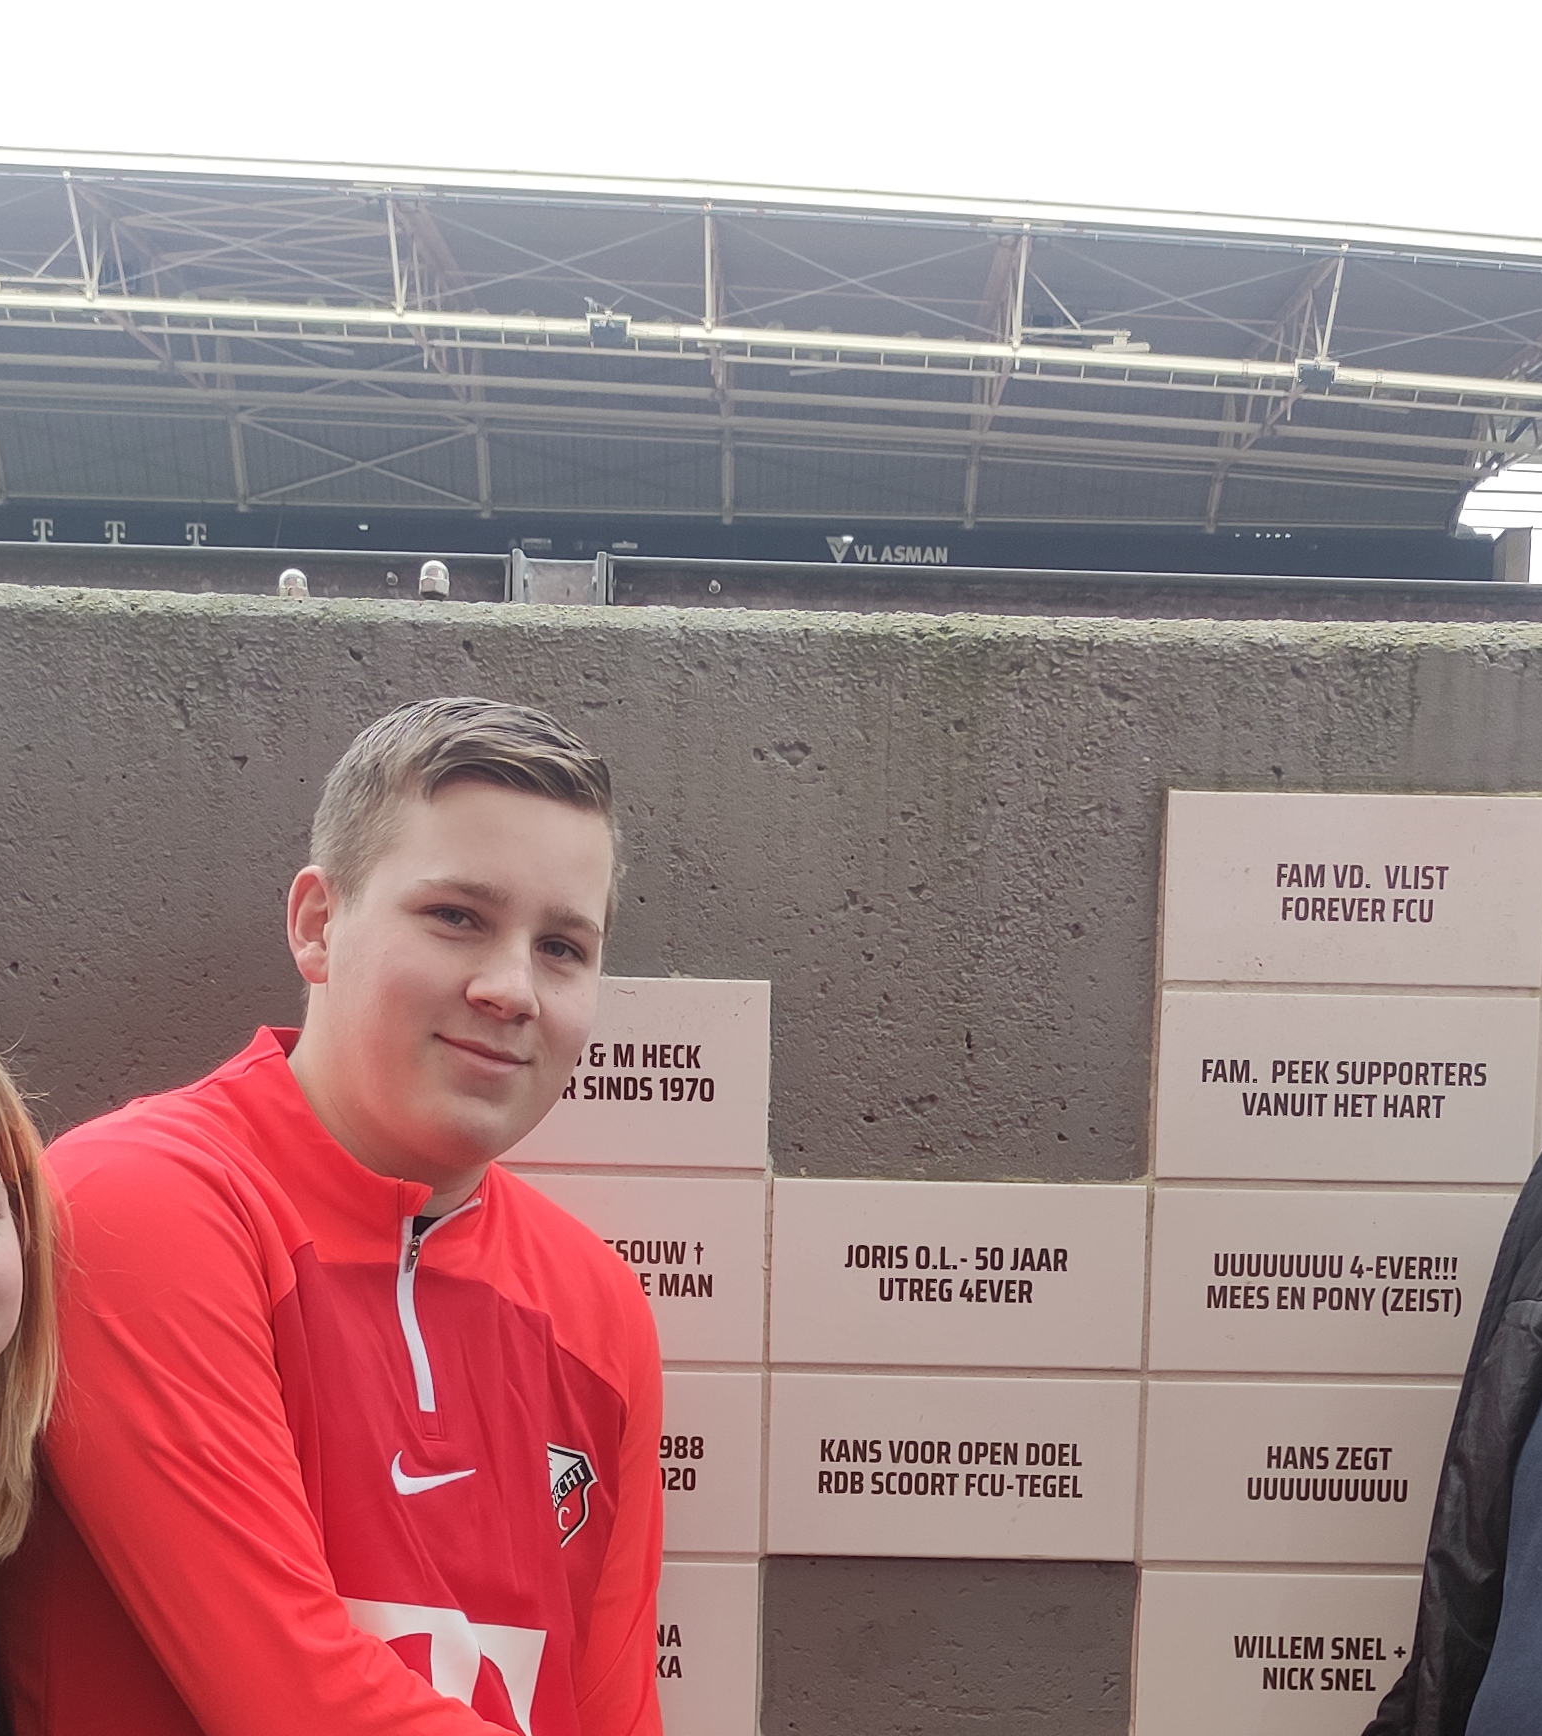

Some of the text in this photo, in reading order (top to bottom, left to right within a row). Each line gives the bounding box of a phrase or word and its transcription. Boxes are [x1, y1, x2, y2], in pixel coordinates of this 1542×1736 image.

[1276, 863, 1450, 890] FAM VD. VLIST
[1281, 896, 1434, 923] FOREVER FCU
[588, 1042, 607, 1068] &
[612, 1043, 635, 1068] M
[642, 1043, 702, 1070] HECK
[1201, 1058, 1487, 1087] FAM. PEEK SUPPORTERS
[582, 1075, 654, 1101] SINDS
[658, 1077, 715, 1102] 1970
[1242, 1092, 1446, 1119] VANUIT HET HART
[844, 1244, 909, 1270] JORIS
[975, 1246, 1004, 1271] 50
[1009, 1247, 1068, 1272] JAAR
[1214, 1253, 1458, 1281] UUUUUUUU 4-EVER!!!
[658, 1272, 713, 1298] MAN
[879, 1277, 1033, 1304] UTREG 4EVER
[1206, 1285, 1462, 1318] MEES EN PONY (ZEIST)
[820, 1438, 1083, 1467] KANS VOOR OPEN DOEL
[1266, 1445, 1393, 1471] HANS ZEGT
[818, 1470, 1083, 1499] RDB SCOORT FCU-TEGEL
[1247, 1477, 1408, 1503] UUUUUUUUUU
[1234, 1635, 1324, 1660] WILLEM
[1330, 1636, 1387, 1661] SNEL
[1262, 1667, 1377, 1692] NICK SNEL
